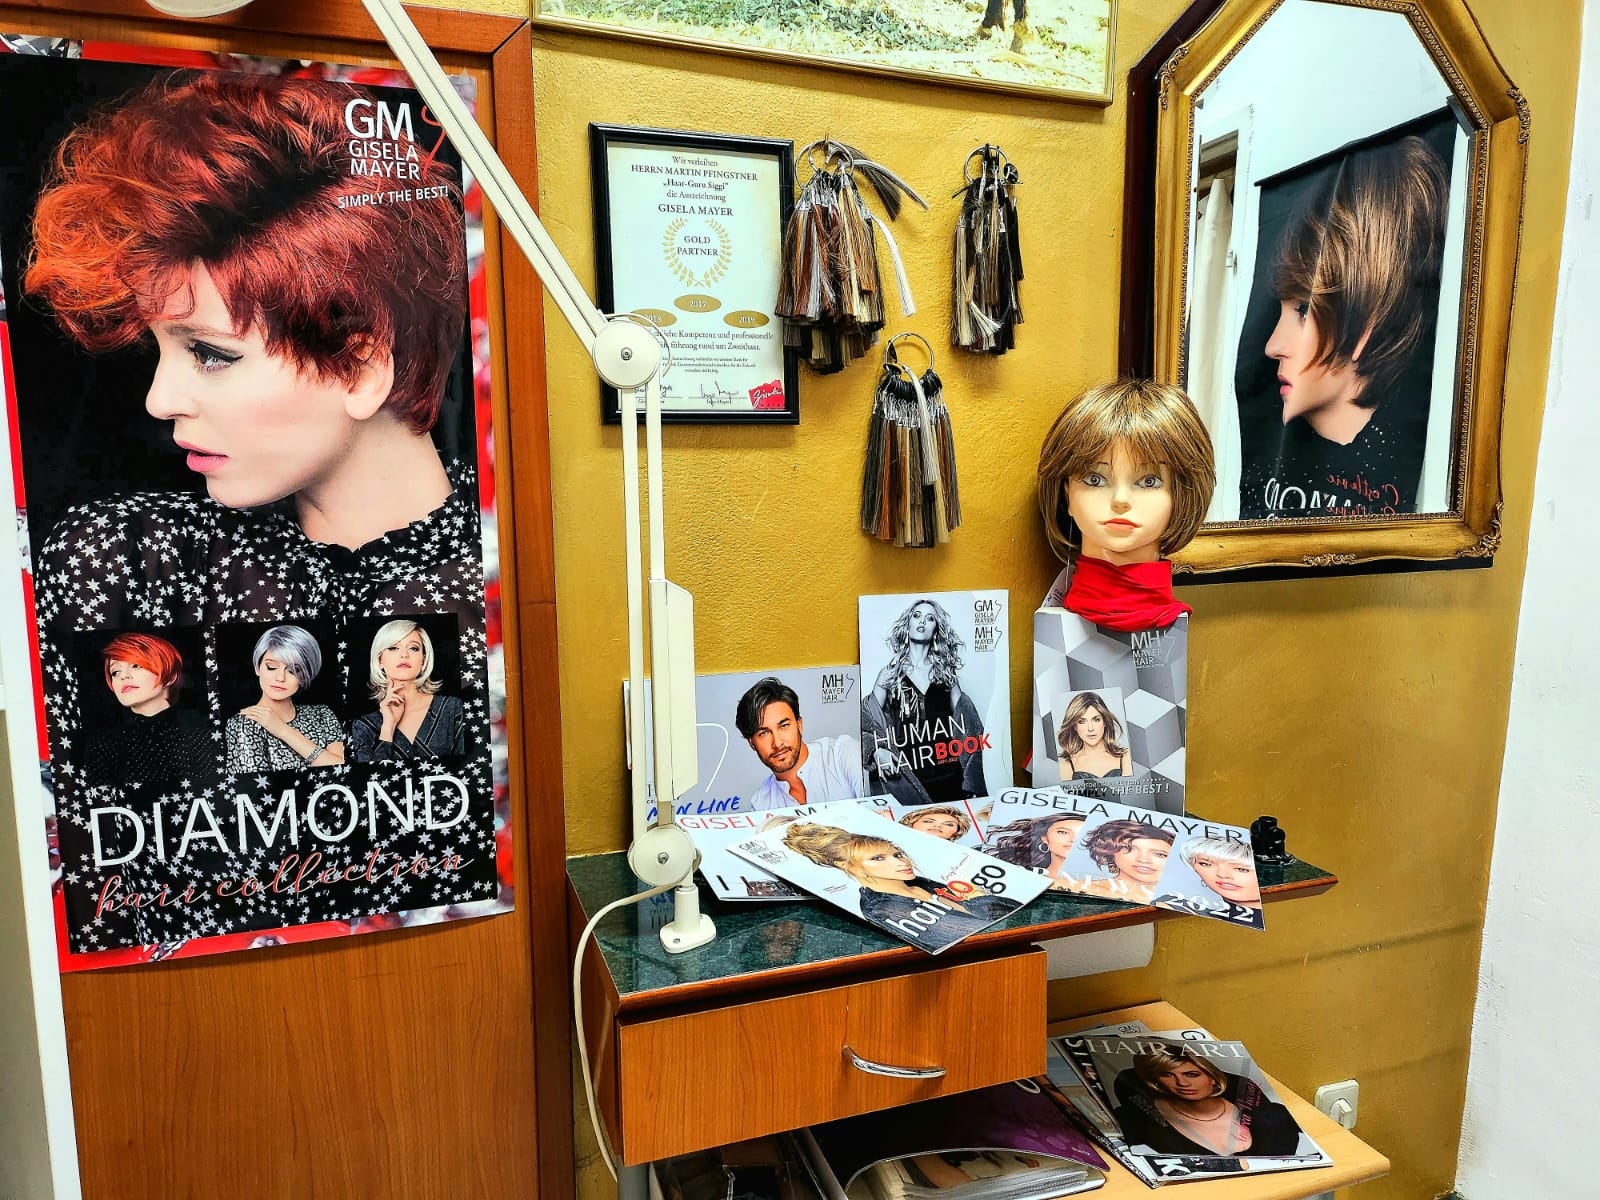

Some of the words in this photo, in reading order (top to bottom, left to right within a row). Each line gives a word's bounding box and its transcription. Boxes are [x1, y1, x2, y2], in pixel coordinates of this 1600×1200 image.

[345, 98, 415, 142] GM
[349, 140, 419, 161] GISELA
[350, 158, 420, 180] MAYER
[672, 156, 687, 166] Wir
[631, 164, 664, 174] HERRN
[665, 166, 701, 176] MARTIN
[703, 169, 758, 181] PFINGSTNER
[338, 191, 384, 209] SIMPLY
[387, 189, 412, 203] THE
[415, 185, 449, 201] BEST!
[658, 203, 695, 214] GISELA
[698, 206, 733, 216] MAYER
[683, 235, 711, 244] GOLD
[677, 247, 719, 257] PARTNER
[689, 300, 707, 308] 2017
[679, 330, 717, 340] Kompetenz
[717, 331, 731, 339] und
[974, 599, 993, 612] GM
[974, 626, 993, 639] MH
[1131, 630, 1160, 650] MH
[1132, 648, 1164, 658] MAYER
[1133, 656, 1155, 666] HAIR
[821, 673, 844, 689] MH
[821, 687, 845, 695] MAYER
[873, 713, 966, 749] HUMAN
[1110, 785, 1134, 796] THE
[696, 795, 741, 815] LINE
[89, 773, 471, 868] DIAMOND
[1000, 789, 1110, 819] GISELA
[1127, 809, 1245, 846] MAYER
[94, 874, 206, 918] hair
[215, 846, 475, 899] collection
[1163, 890, 1255, 924] 2022
[1085, 1039, 1175, 1057] HAIR
[1179, 1042, 1246, 1059] ART
